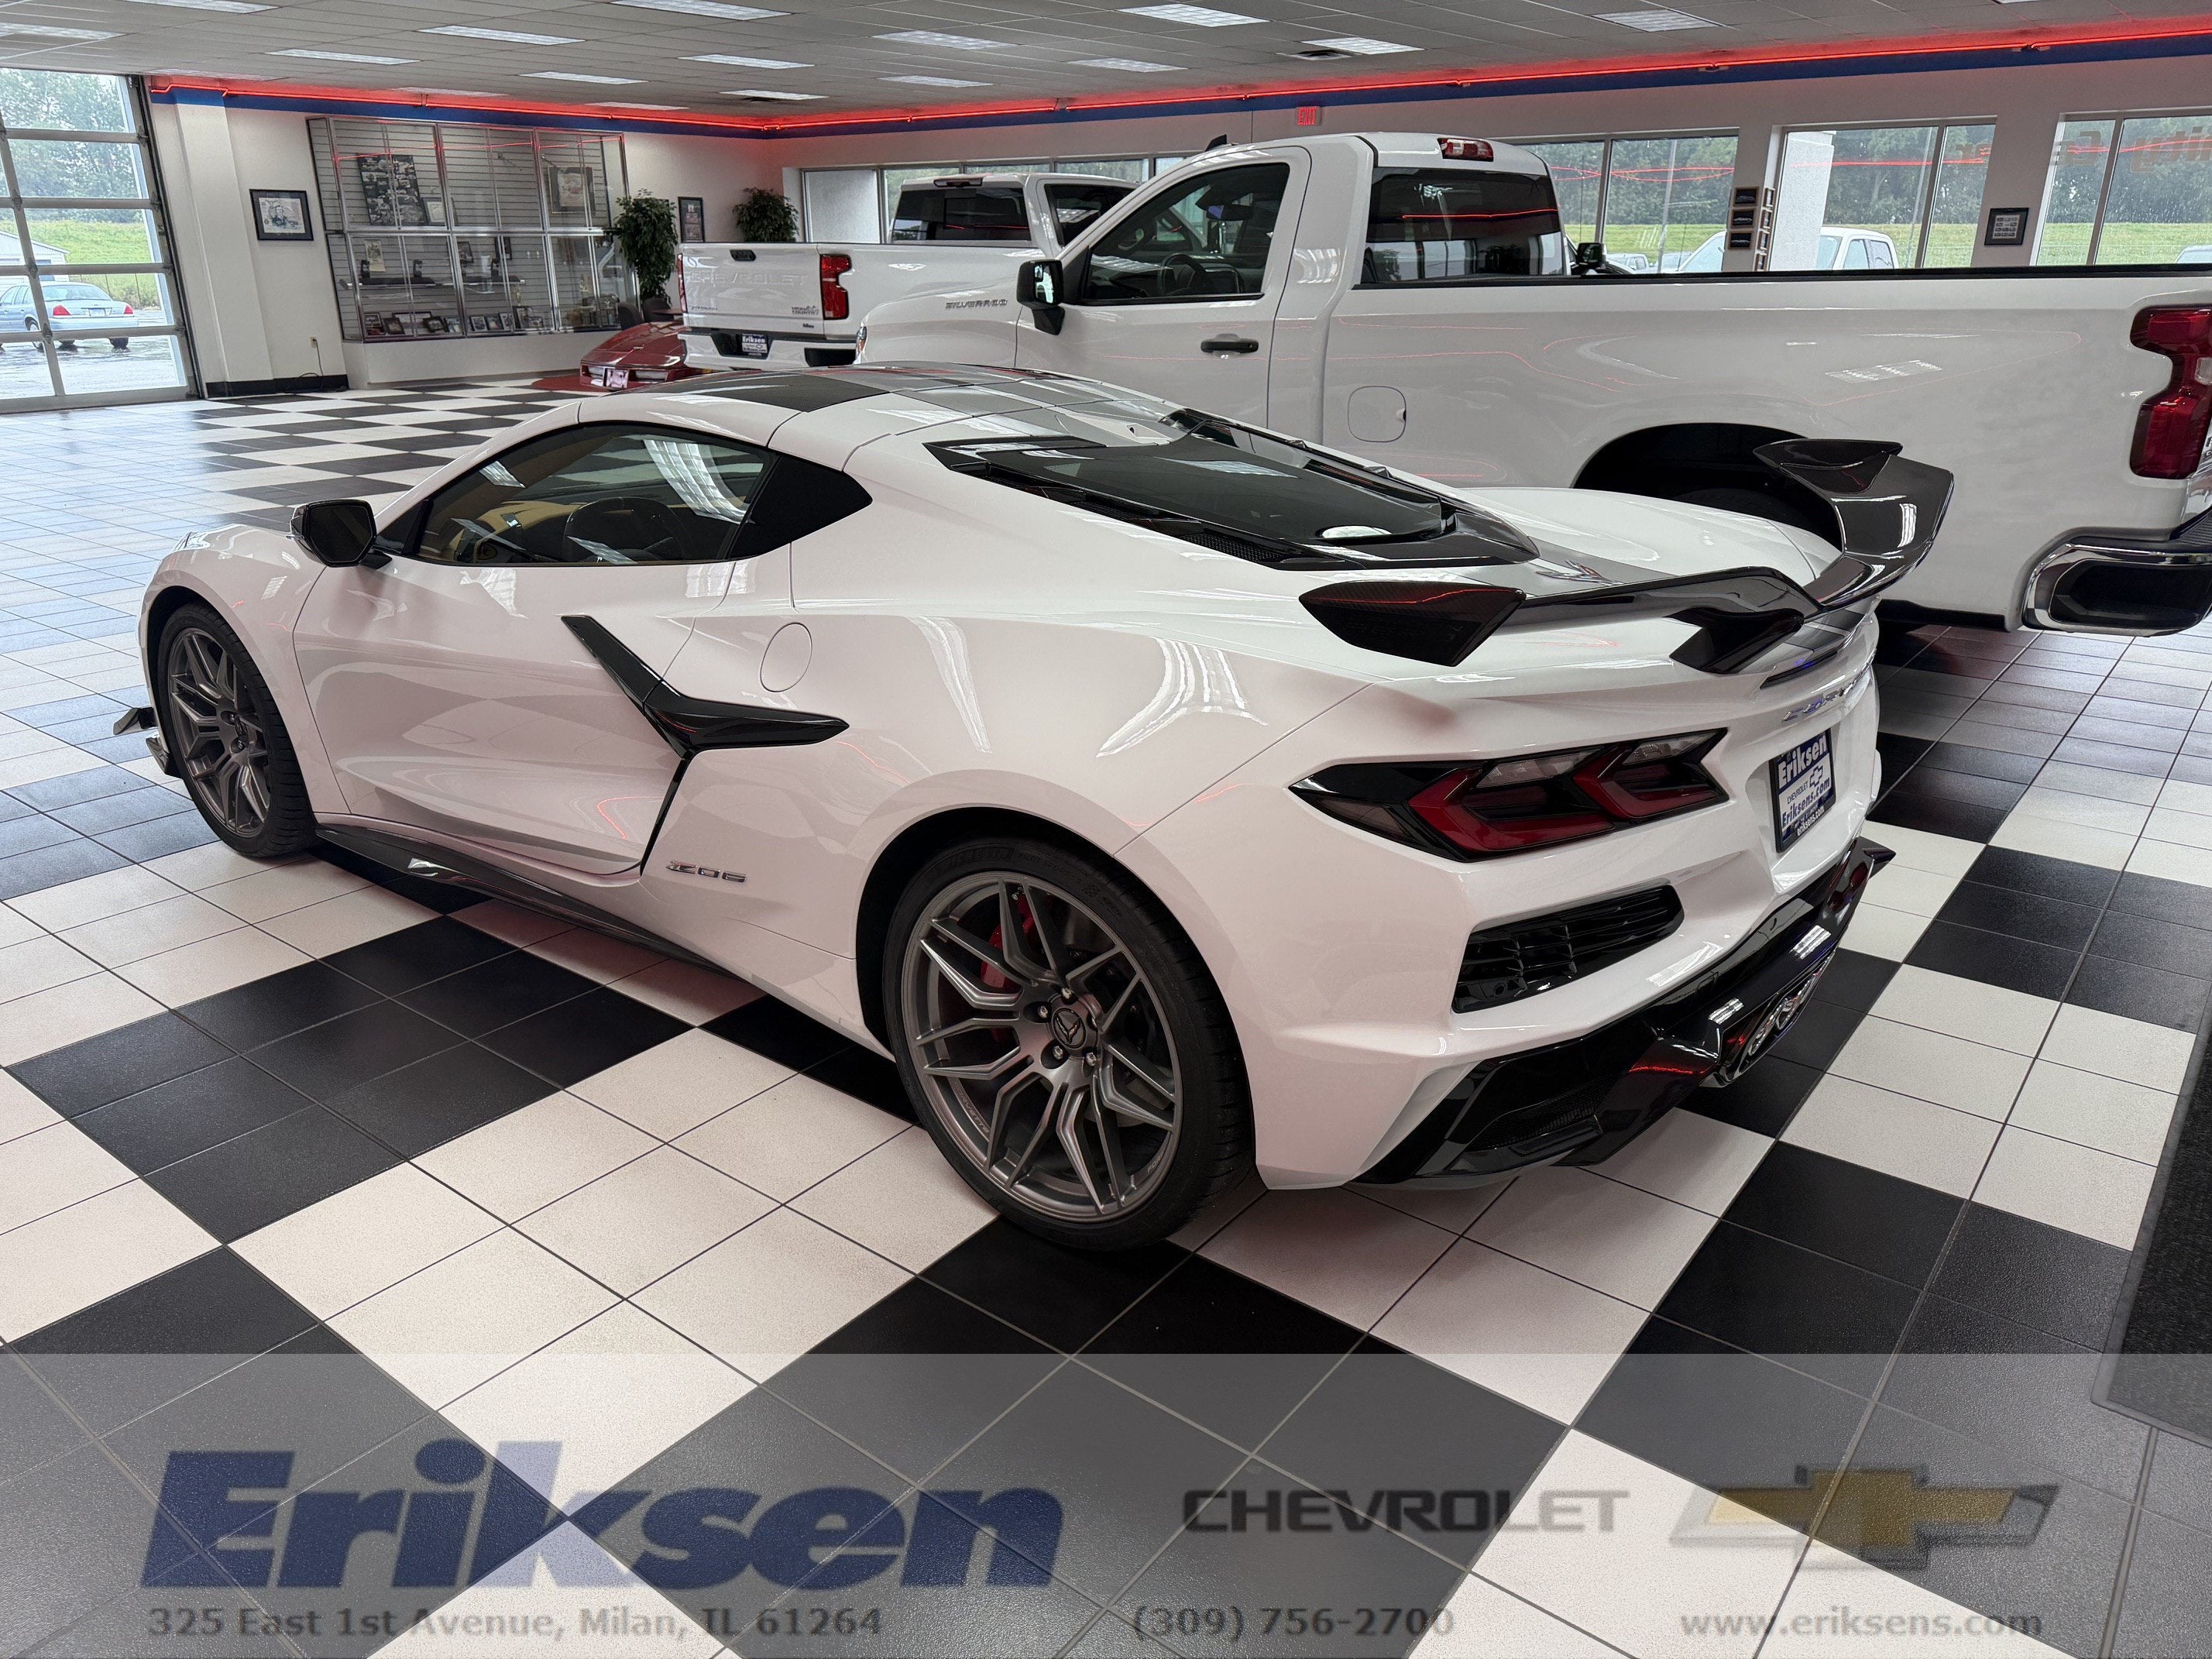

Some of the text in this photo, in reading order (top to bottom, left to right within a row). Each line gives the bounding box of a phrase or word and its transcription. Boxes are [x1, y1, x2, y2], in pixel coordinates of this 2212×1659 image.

[1297, 106, 1317, 125] EXIT
[945, 298, 1008, 309] SILVERADO
[1778, 735, 1827, 788] Eriksen
[1781, 777, 1830, 827] Eriksens.com
[1787, 781, 1808, 804] CHEVROLET
[1797, 805, 1825, 836] eriksens.com
[665, 860, 747, 883] Z06
